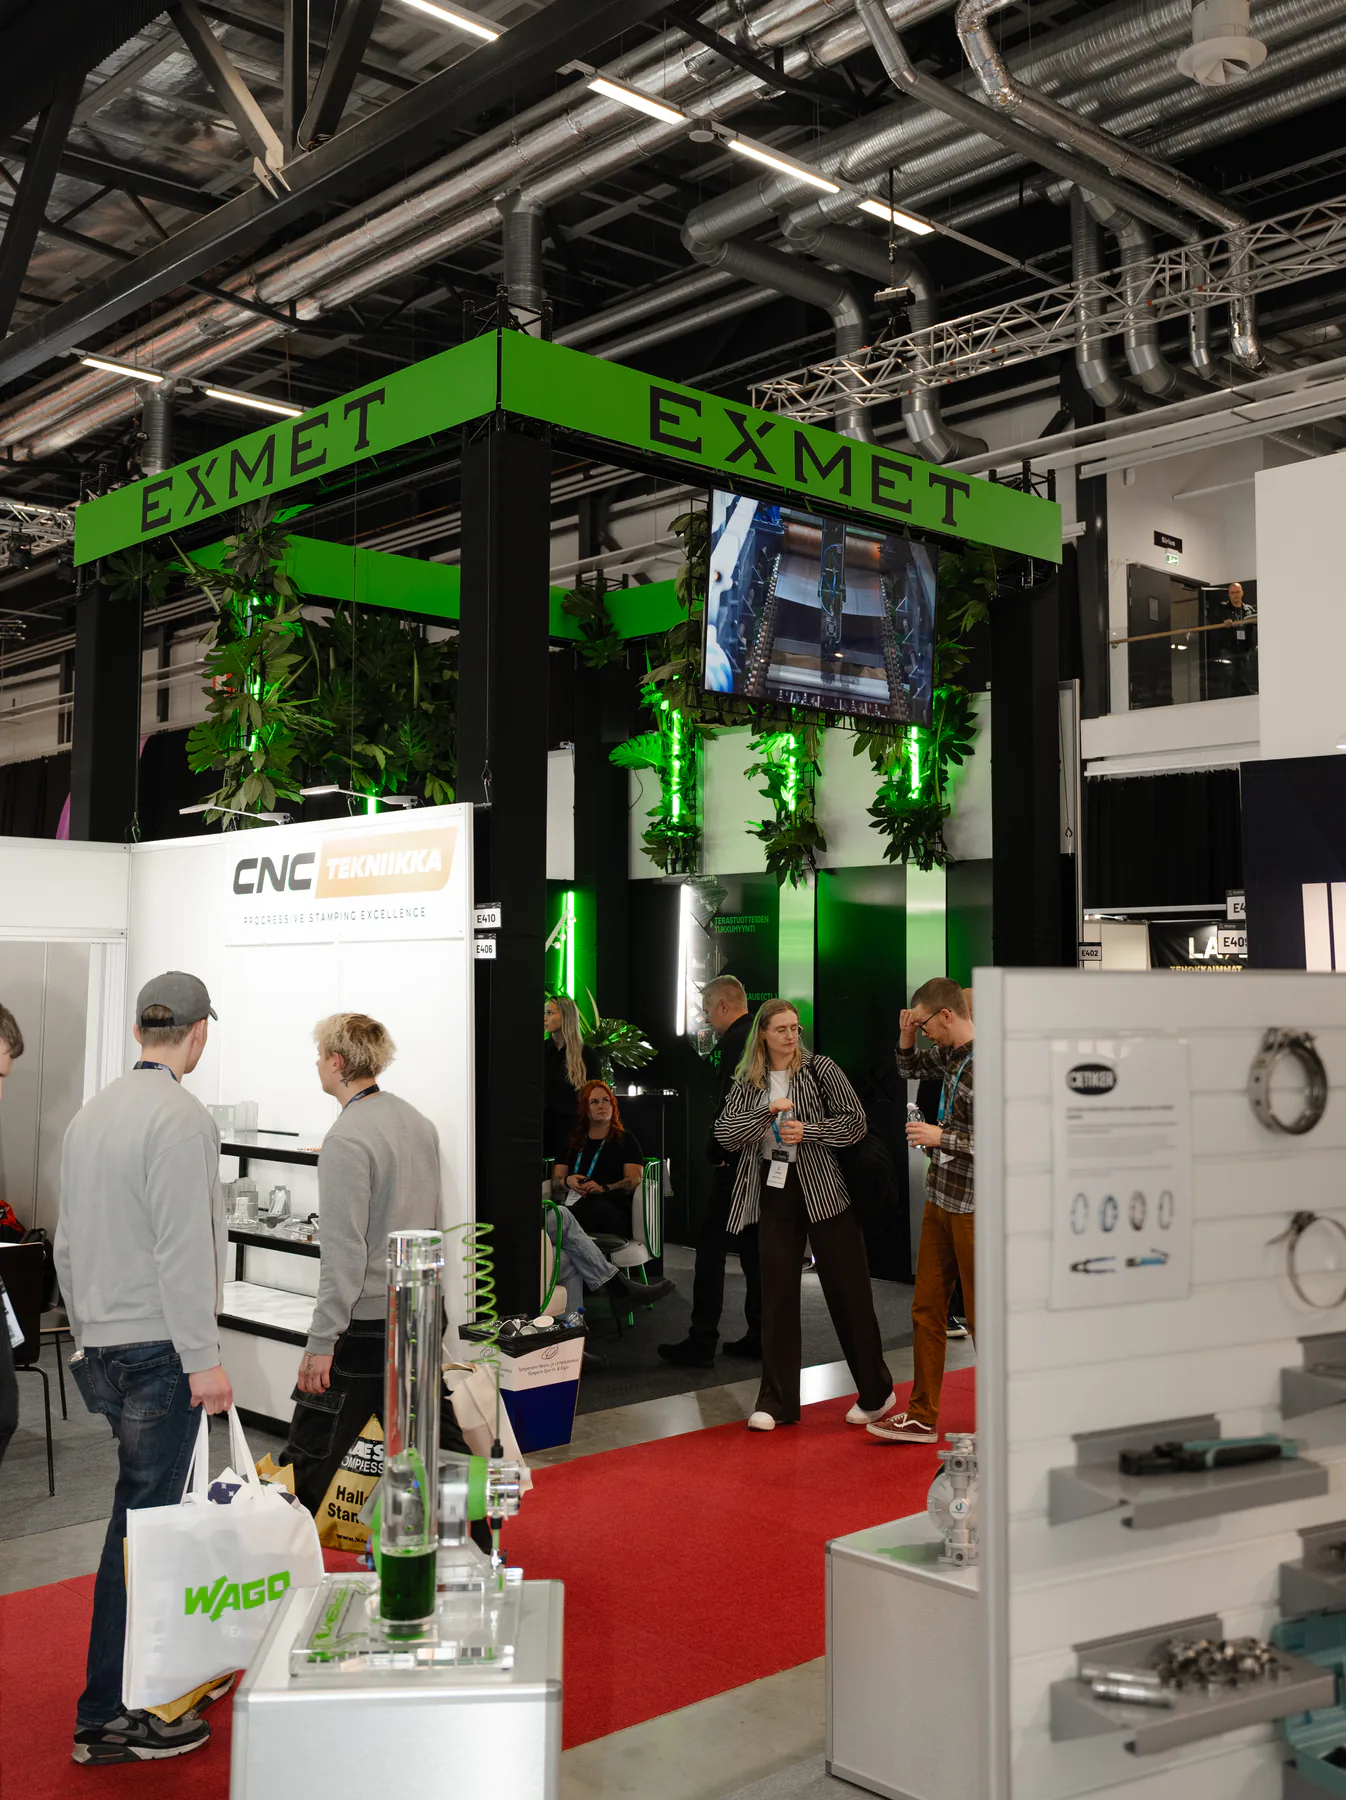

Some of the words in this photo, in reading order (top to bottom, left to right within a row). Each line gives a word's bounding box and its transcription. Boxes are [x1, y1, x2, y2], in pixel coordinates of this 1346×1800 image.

[141, 387, 386, 533] EXMET
[650, 385, 970, 527] EXMET
[233, 852, 316, 895] CNC
[327, 849, 442, 880] TEKNIIKKA
[243, 913, 305, 926] PROGRESSIVE
[308, 910, 357, 923] STAMPING
[360, 906, 427, 920] EXCELLENCE
[476, 914, 496, 924] E410
[714, 924, 756, 933] TUKKUMYYNTI
[476, 944, 493, 954] E406
[1081, 949, 1099, 957] E402
[327, 1502, 367, 1526] Stan
[184, 1569, 291, 1623] WAGO
